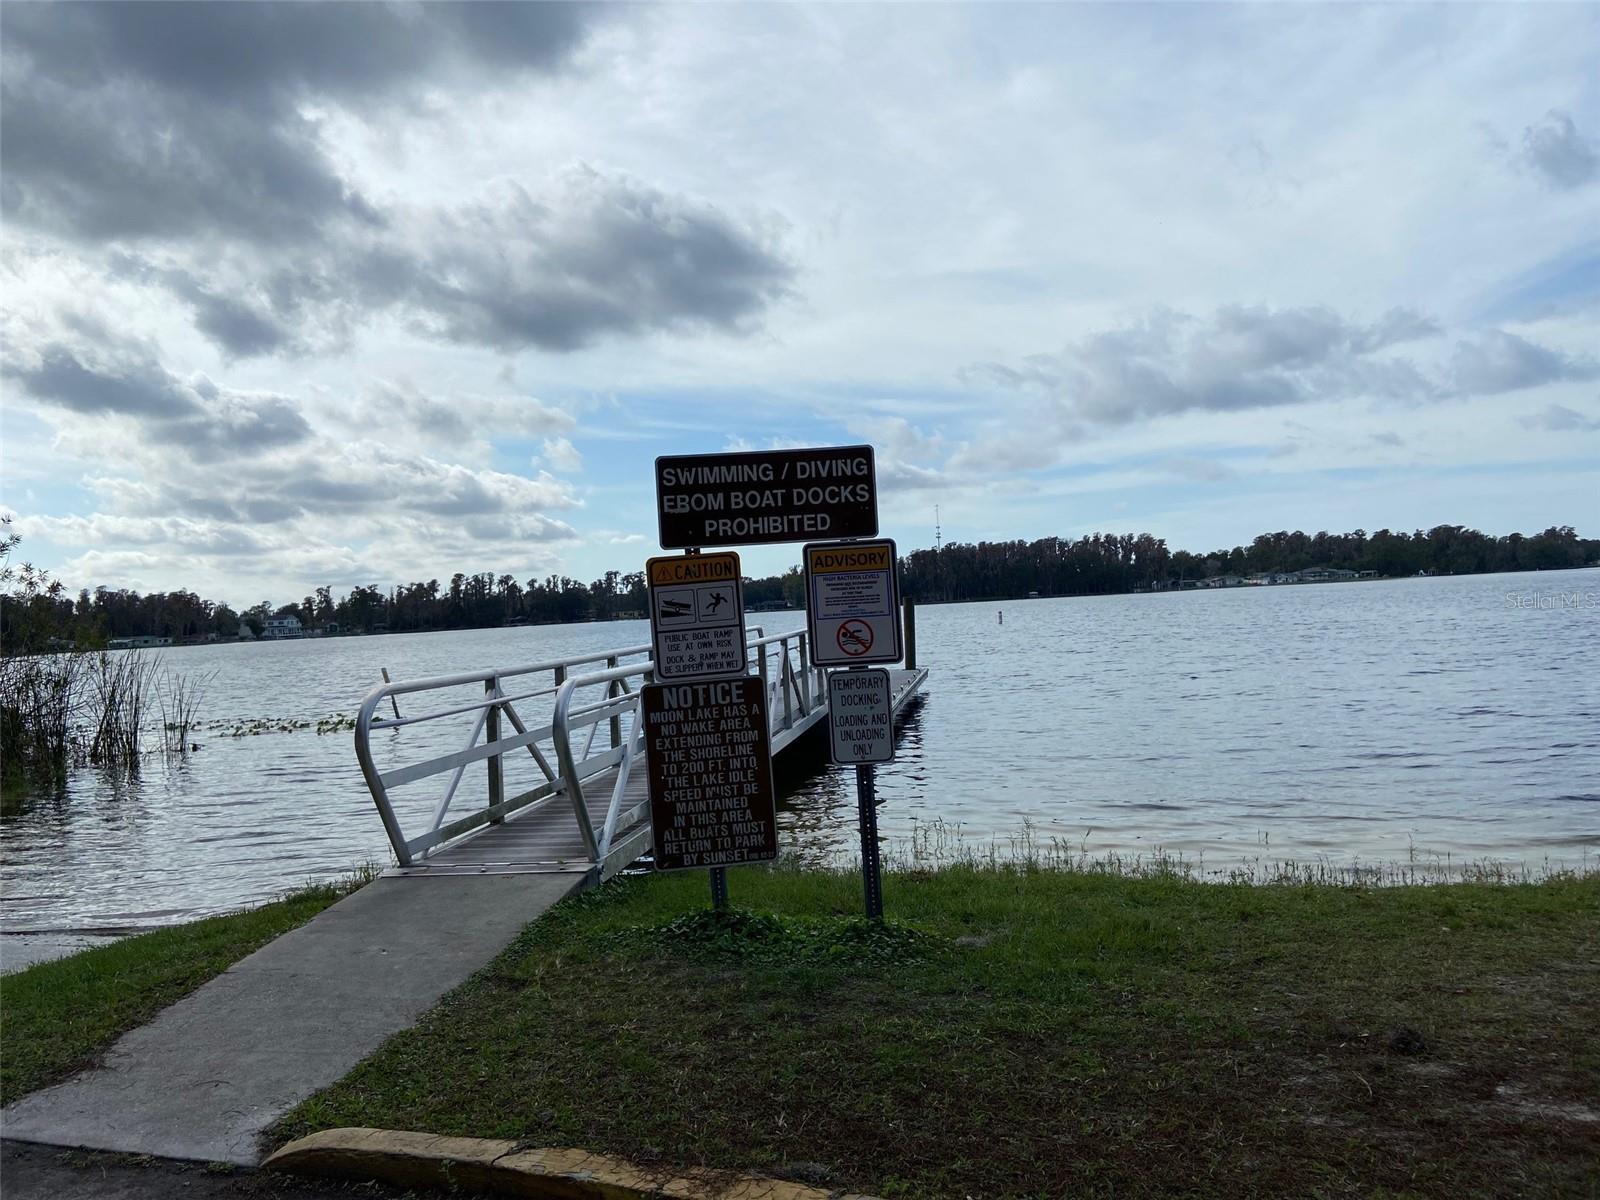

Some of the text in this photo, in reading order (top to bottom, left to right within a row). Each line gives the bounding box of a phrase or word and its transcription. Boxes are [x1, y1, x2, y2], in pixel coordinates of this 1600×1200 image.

[662, 457, 868, 486] SWIMMING / DIVING
[731, 490, 785, 509] BOAT
[793, 484, 869, 505] DOCKS
[705, 513, 831, 536] PROHIBITED
[814, 552, 886, 568] ADVISORY
[674, 561, 732, 580] CAUTION
[664, 629, 734, 642] PUBLIC BOAT RAMP
[685, 642, 694, 650] AT
[698, 641, 713, 649] OWN
[717, 639, 732, 648] RISK
[665, 660, 738, 674] BE SLIPPERY WHEN WET
[666, 655, 684, 664] DOCK
[688, 654, 696, 662] &
[700, 653, 718, 662] RAMP
[832, 677, 884, 691] TEMPORARY
[663, 682, 744, 710] NOTICE
[841, 693, 878, 706] DOCKING
[650, 704, 760, 723] MOON LAKE HAS A
[835, 713, 887, 727] LOADING AND
[661, 718, 751, 736] NO WAKE AREA
[840, 728, 885, 741] UNLOADING
[656, 731, 759, 750] EXTENDING FROM
[664, 744, 754, 762] THE SHORELINE
[853, 744, 873, 756] ONLY
[661, 756, 756, 776] TO 200 FT. INTO
[666, 770, 755, 788] THE LAKE IDLE
[664, 783, 759, 802] SPEED MUST BE
[676, 797, 748, 814] MAINTAINED
[674, 809, 752, 828] IN THIS AREA
[664, 828, 686, 842] ALL
[733, 821, 765, 834] MUST
[665, 834, 765, 855] RETURN TO PARK
[683, 853, 698, 865] BY
[704, 850, 750, 864] SUNSET
